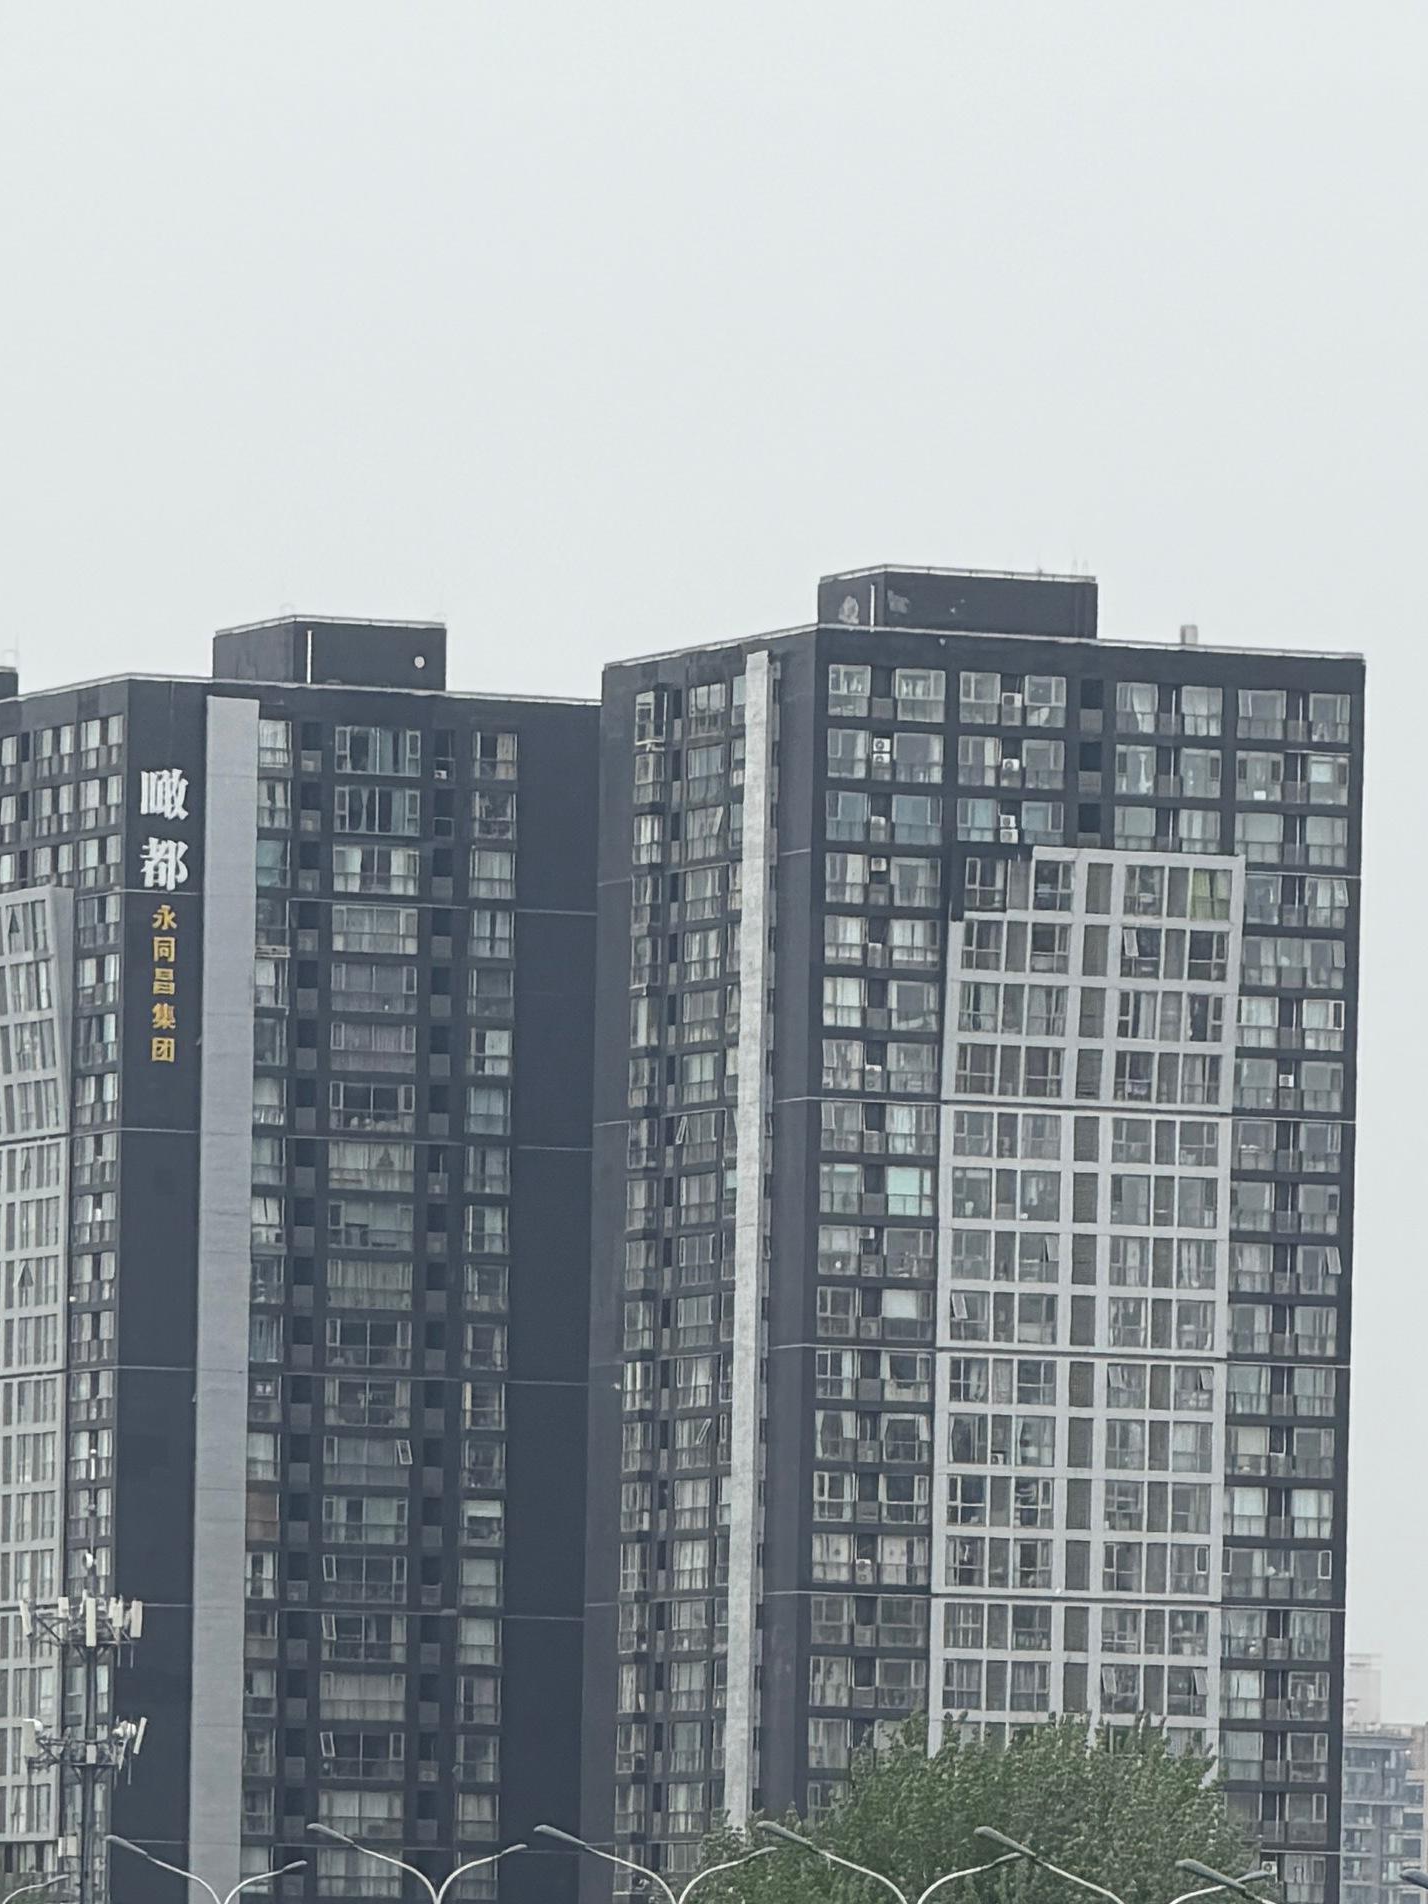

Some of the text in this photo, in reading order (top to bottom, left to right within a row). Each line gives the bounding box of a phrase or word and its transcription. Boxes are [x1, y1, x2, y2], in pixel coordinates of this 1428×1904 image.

[151, 904, 178, 1063] 永同昌集团
